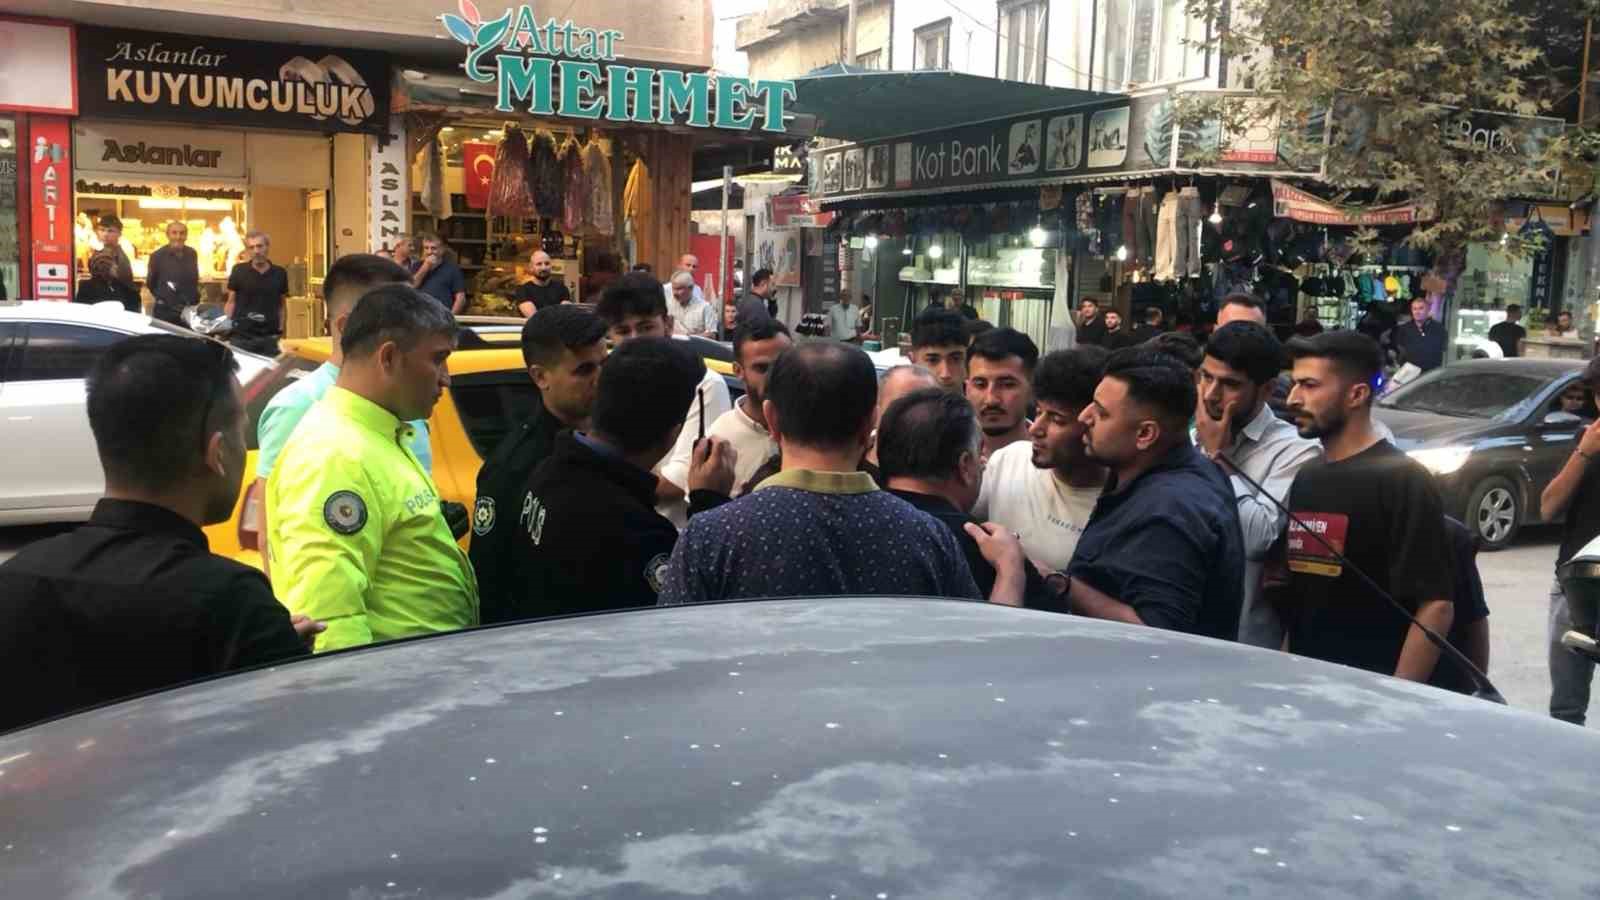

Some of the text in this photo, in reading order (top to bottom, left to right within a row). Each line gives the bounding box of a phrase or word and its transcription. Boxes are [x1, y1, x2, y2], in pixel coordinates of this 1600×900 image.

[105, 42, 227, 68] Aslanlar
[503, 5, 623, 61] Attar
[106, 67, 368, 119] KUYUMCULUK
[495, 54, 798, 133] MEHMET
[102, 138, 222, 169] Aslanlar
[914, 133, 1002, 181] Kot Bank
